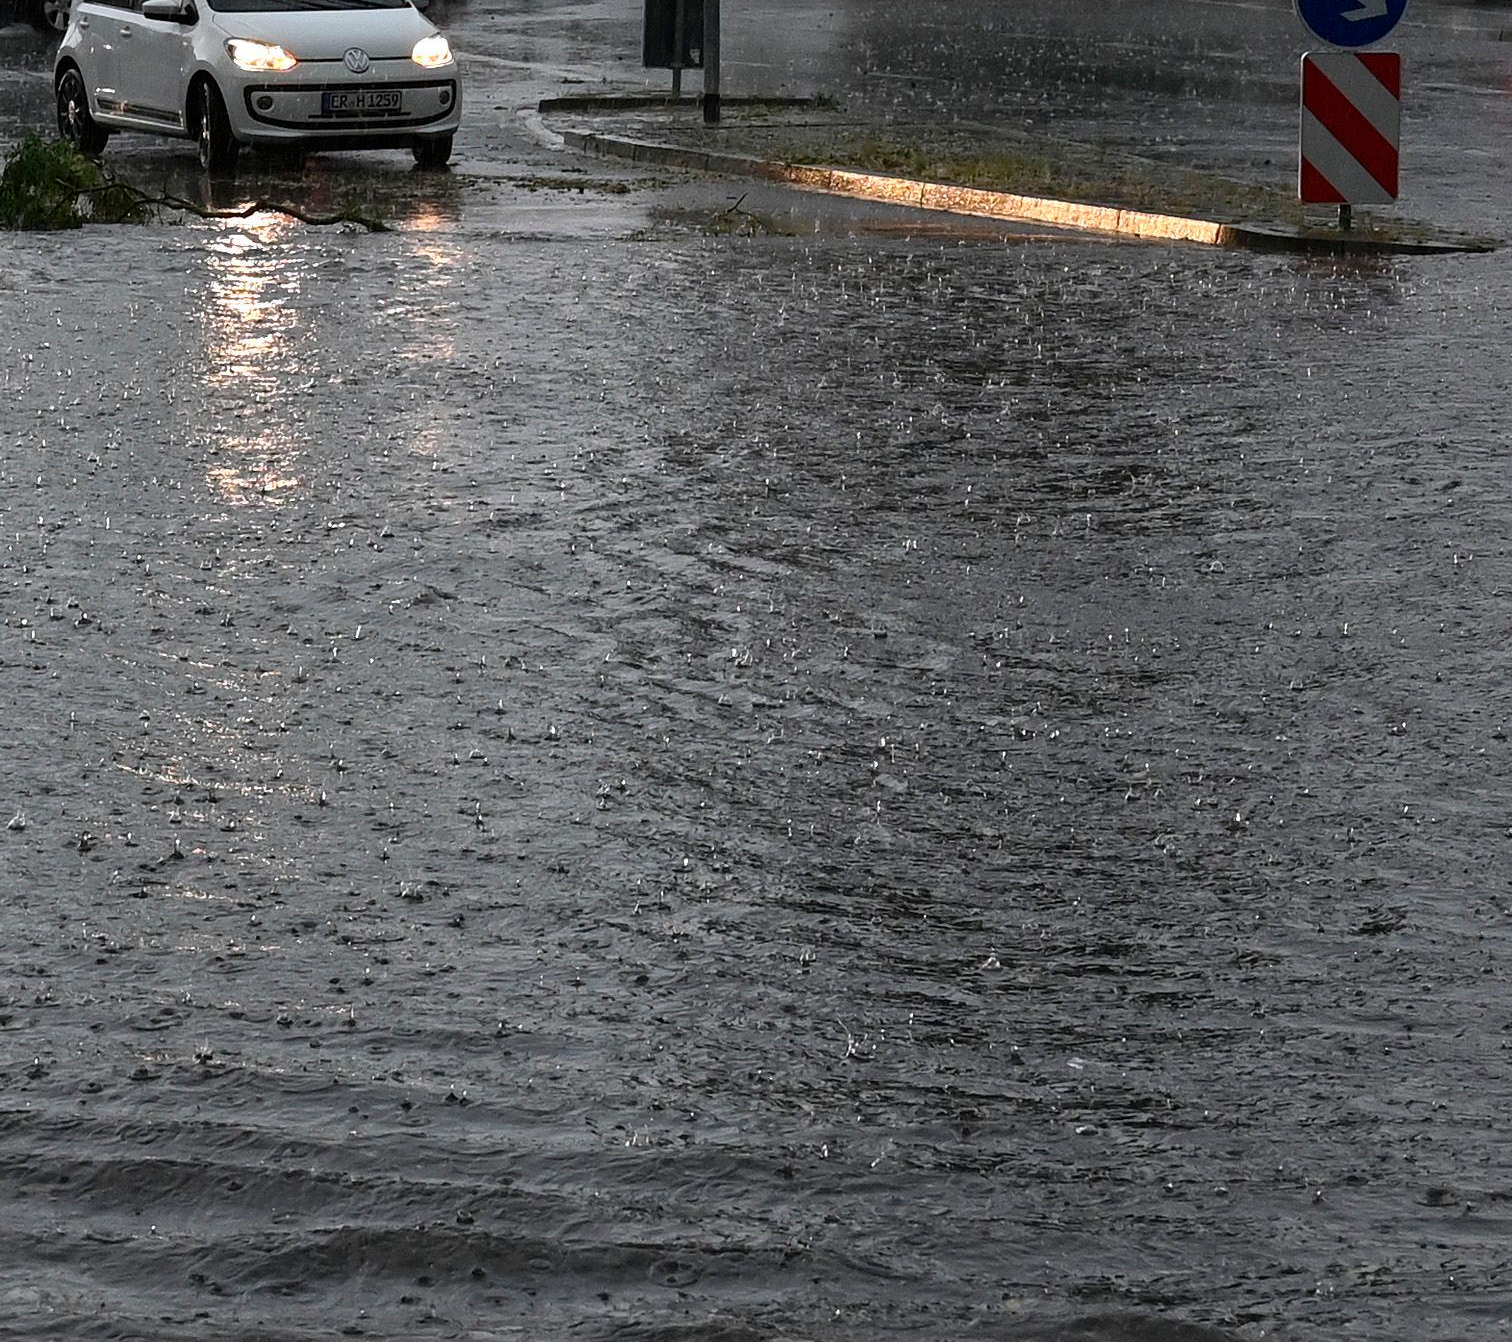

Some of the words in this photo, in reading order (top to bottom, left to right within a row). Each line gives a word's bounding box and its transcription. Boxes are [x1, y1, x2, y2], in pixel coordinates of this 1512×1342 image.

[331, 95, 348, 109] ER
[356, 94, 365, 108] H
[368, 93, 399, 108] 1259
